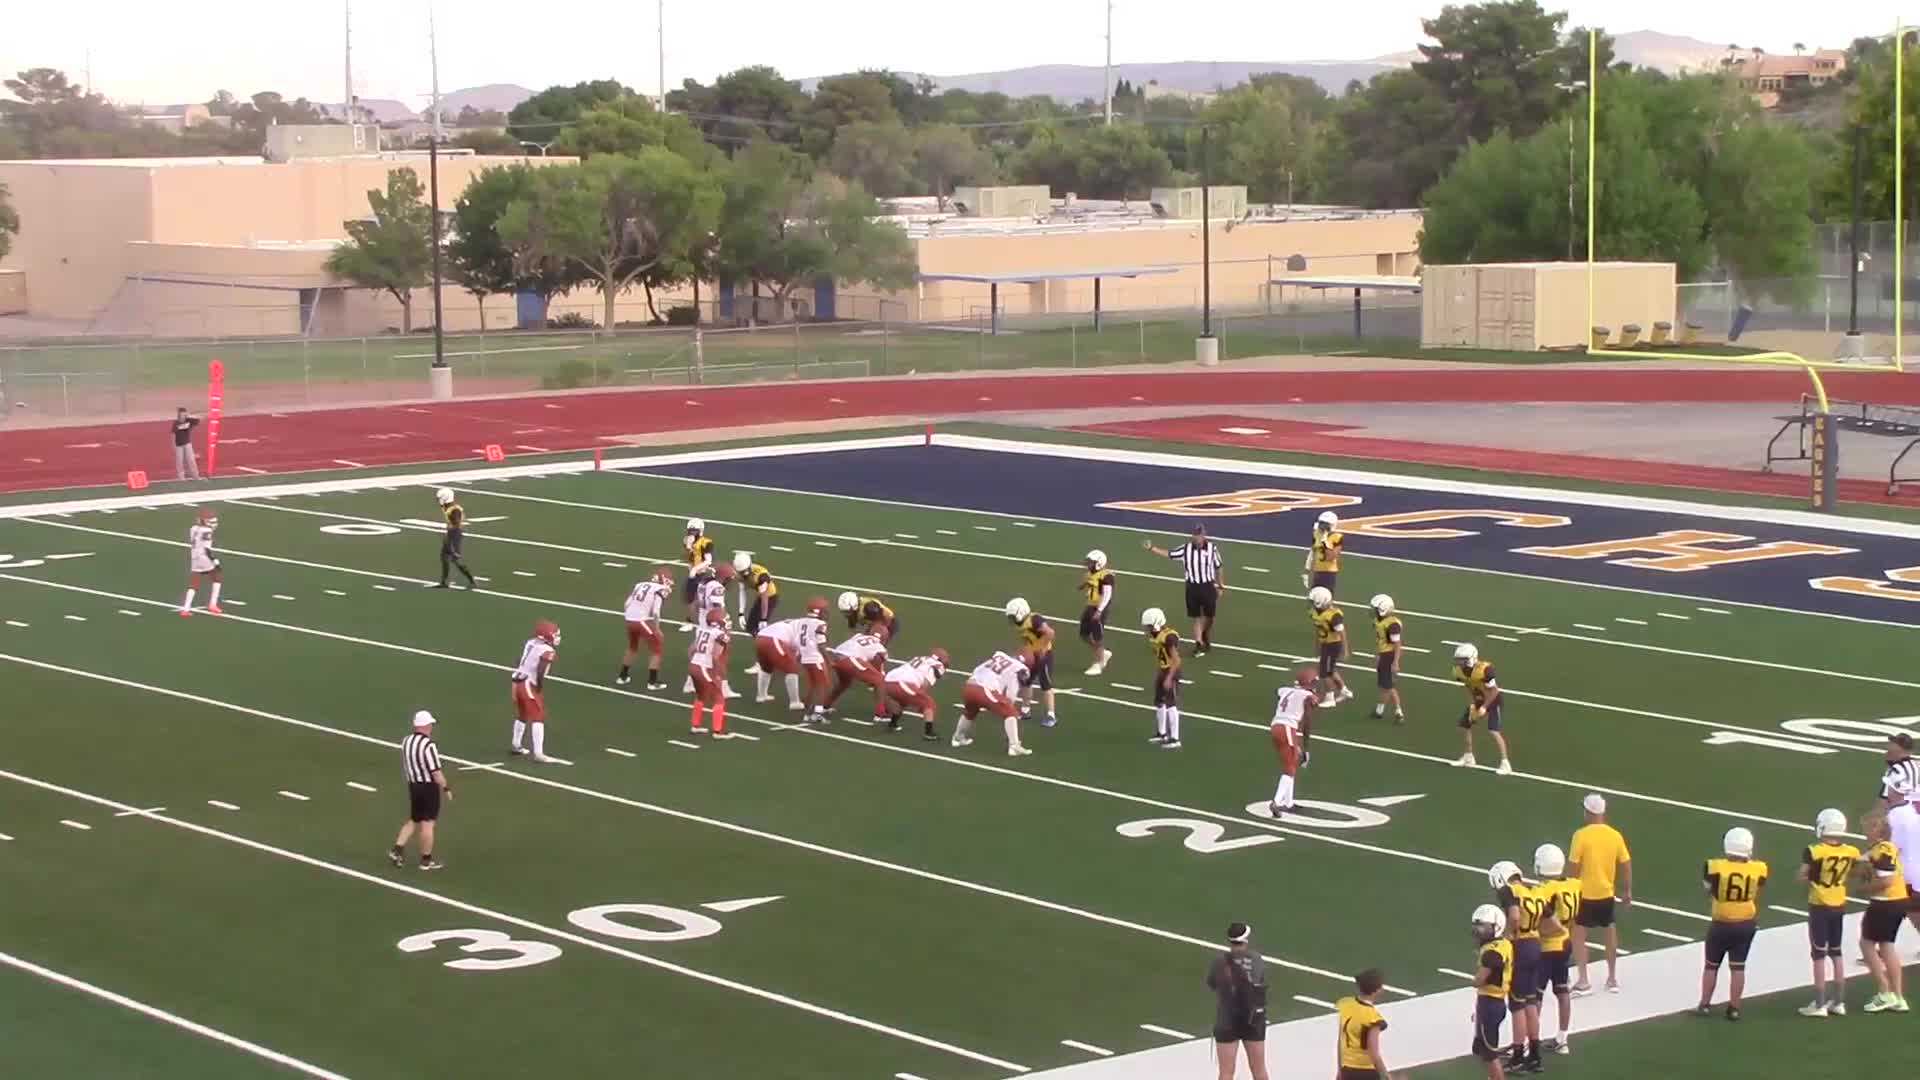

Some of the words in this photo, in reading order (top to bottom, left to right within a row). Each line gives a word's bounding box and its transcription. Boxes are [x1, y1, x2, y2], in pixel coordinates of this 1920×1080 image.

[695, 629, 711, 654] 12
[800, 624, 807, 646] 2
[1280, 690, 1295, 712] 4
[1115, 799, 1391, 853] 20
[1726, 872, 1751, 902] 61
[1824, 856, 1850, 888] 32
[1520, 896, 1546, 933] 50
[397, 903, 723, 970] 30
